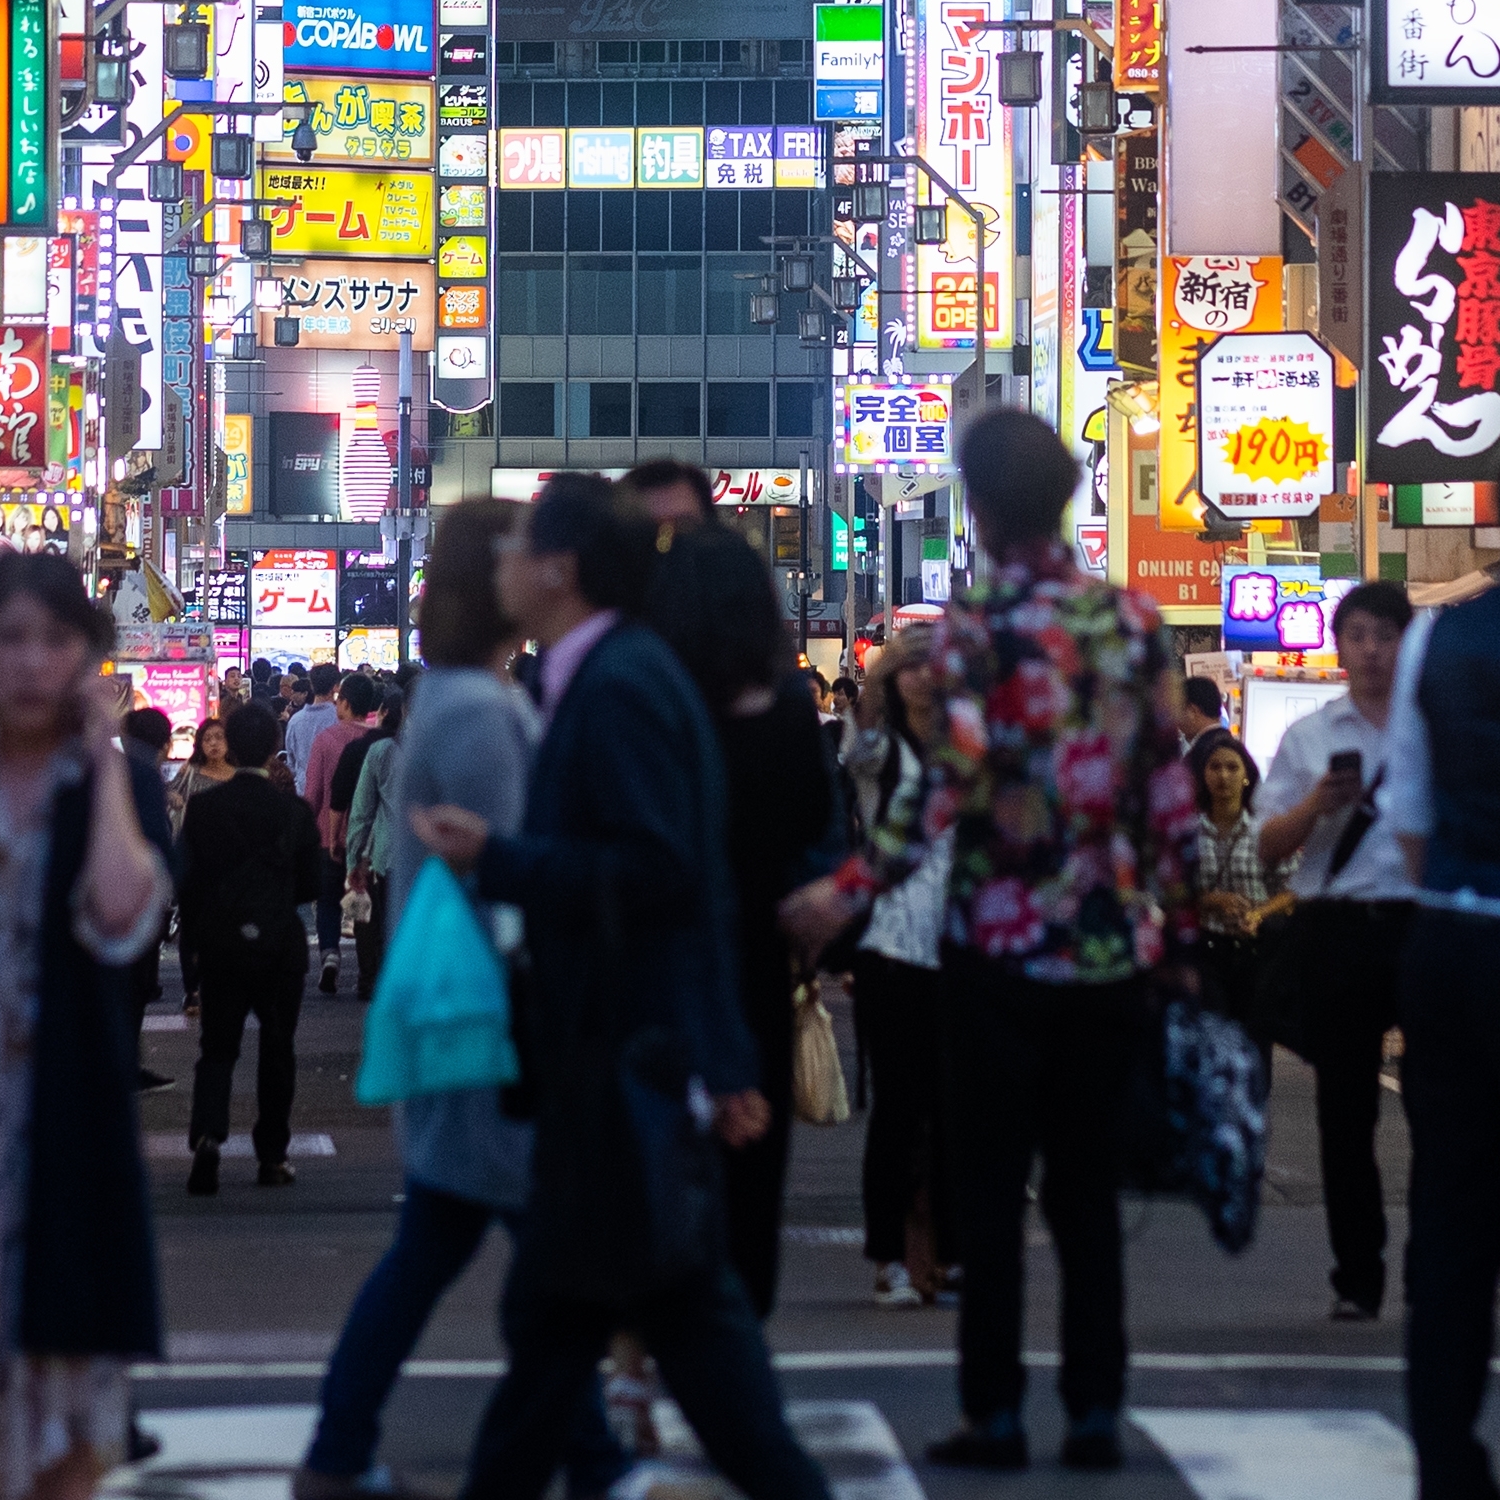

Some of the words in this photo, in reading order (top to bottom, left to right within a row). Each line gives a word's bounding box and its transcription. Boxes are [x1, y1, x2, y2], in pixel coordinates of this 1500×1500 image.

[853, 91, 879, 113] 酒
[940, 1, 993, 191] マンボー
[18, 68, 41, 186] 楽しいお店
[344, 137, 413, 160] ゲラゲラ
[502, 134, 562, 182] つり具
[727, 132, 773, 157] TAX
[573, 136, 631, 182] Fishing
[641, 135, 700, 182] 釣具
[268, 174, 326, 191] 地域最大!!
[388, 179, 414, 190] メダル
[717, 163, 764, 184] 免税
[270, 196, 371, 241] ゲーム
[384, 205, 417, 216] TVゲーム
[441, 251, 484, 265] ゲーム
[1331, 208, 1348, 324] 劇場通り一番街
[282, 276, 420, 313] メンズサウナ
[446, 292, 479, 302] メンズ
[1179, 270, 1251, 311] 新宿
[1204, 310, 1229, 328] の
[854, 394, 918, 424] 完全
[883, 425, 946, 454] 個室
[1231, 426, 1319, 467] 190円
[1137, 559, 1195, 578] ONLINE
[258, 587, 332, 614] ゲーム
[1178, 582, 1199, 601] B1
[1279, 580, 1325, 597] フリー
[1228, 571, 1325, 650] 麻雀
